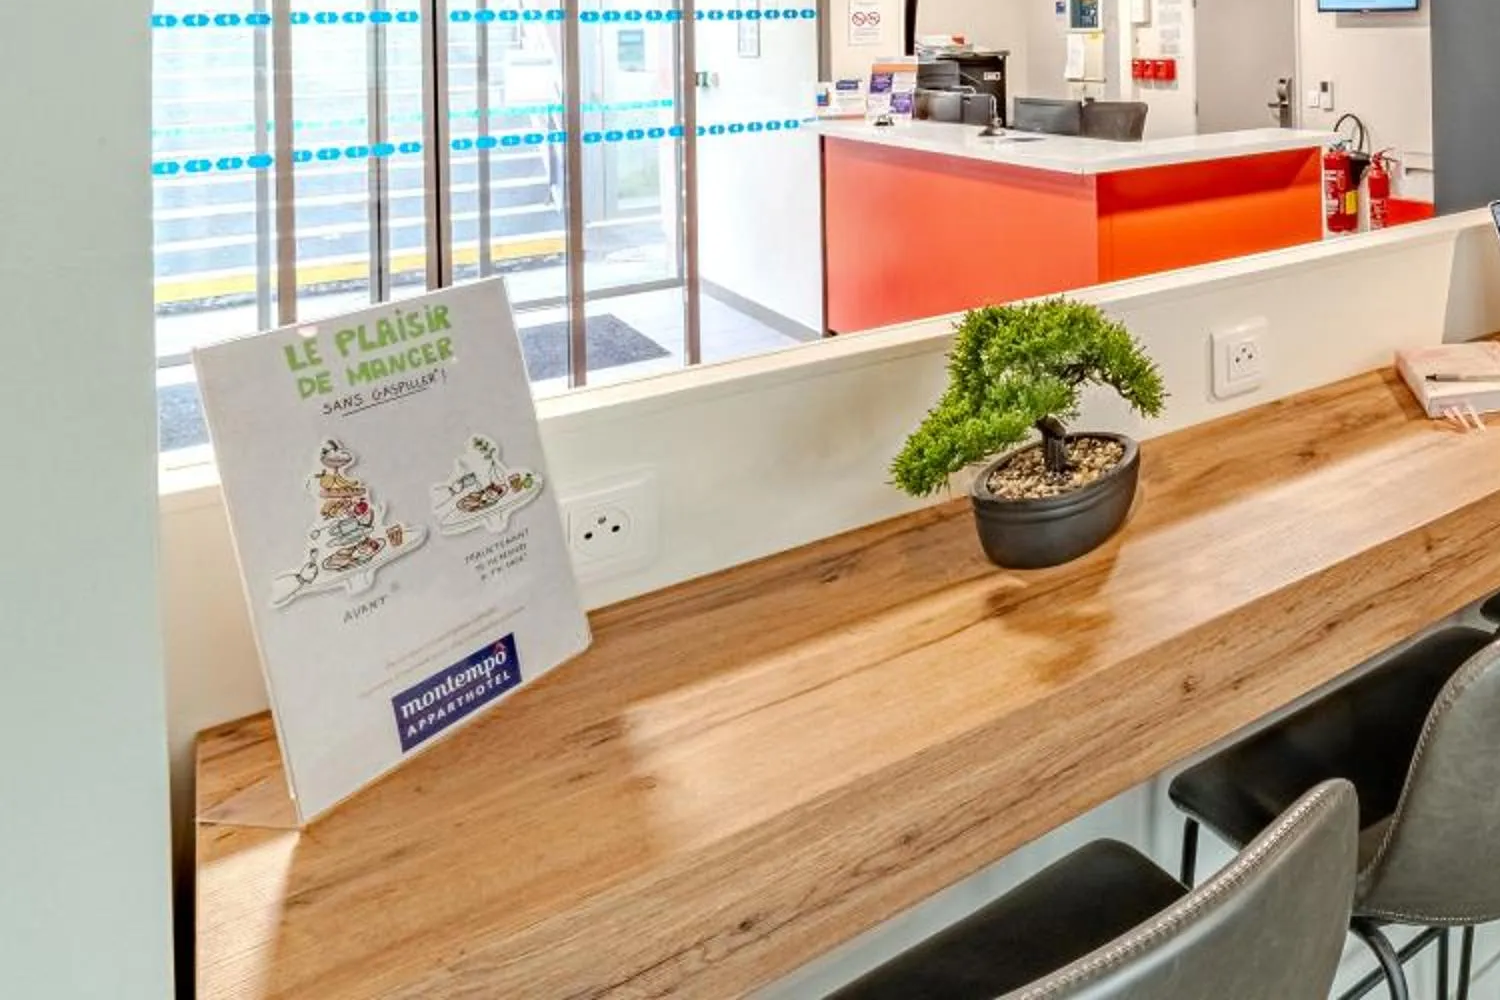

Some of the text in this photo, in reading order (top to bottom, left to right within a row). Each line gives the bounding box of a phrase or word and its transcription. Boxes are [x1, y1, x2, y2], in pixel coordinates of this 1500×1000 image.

[283, 337, 323, 372] LE
[297, 370, 334, 400] DE
[321, 393, 365, 416] SANS
[342, 595, 388, 624] AVANT
[406, 669, 512, 739] APPARTHOTEL
